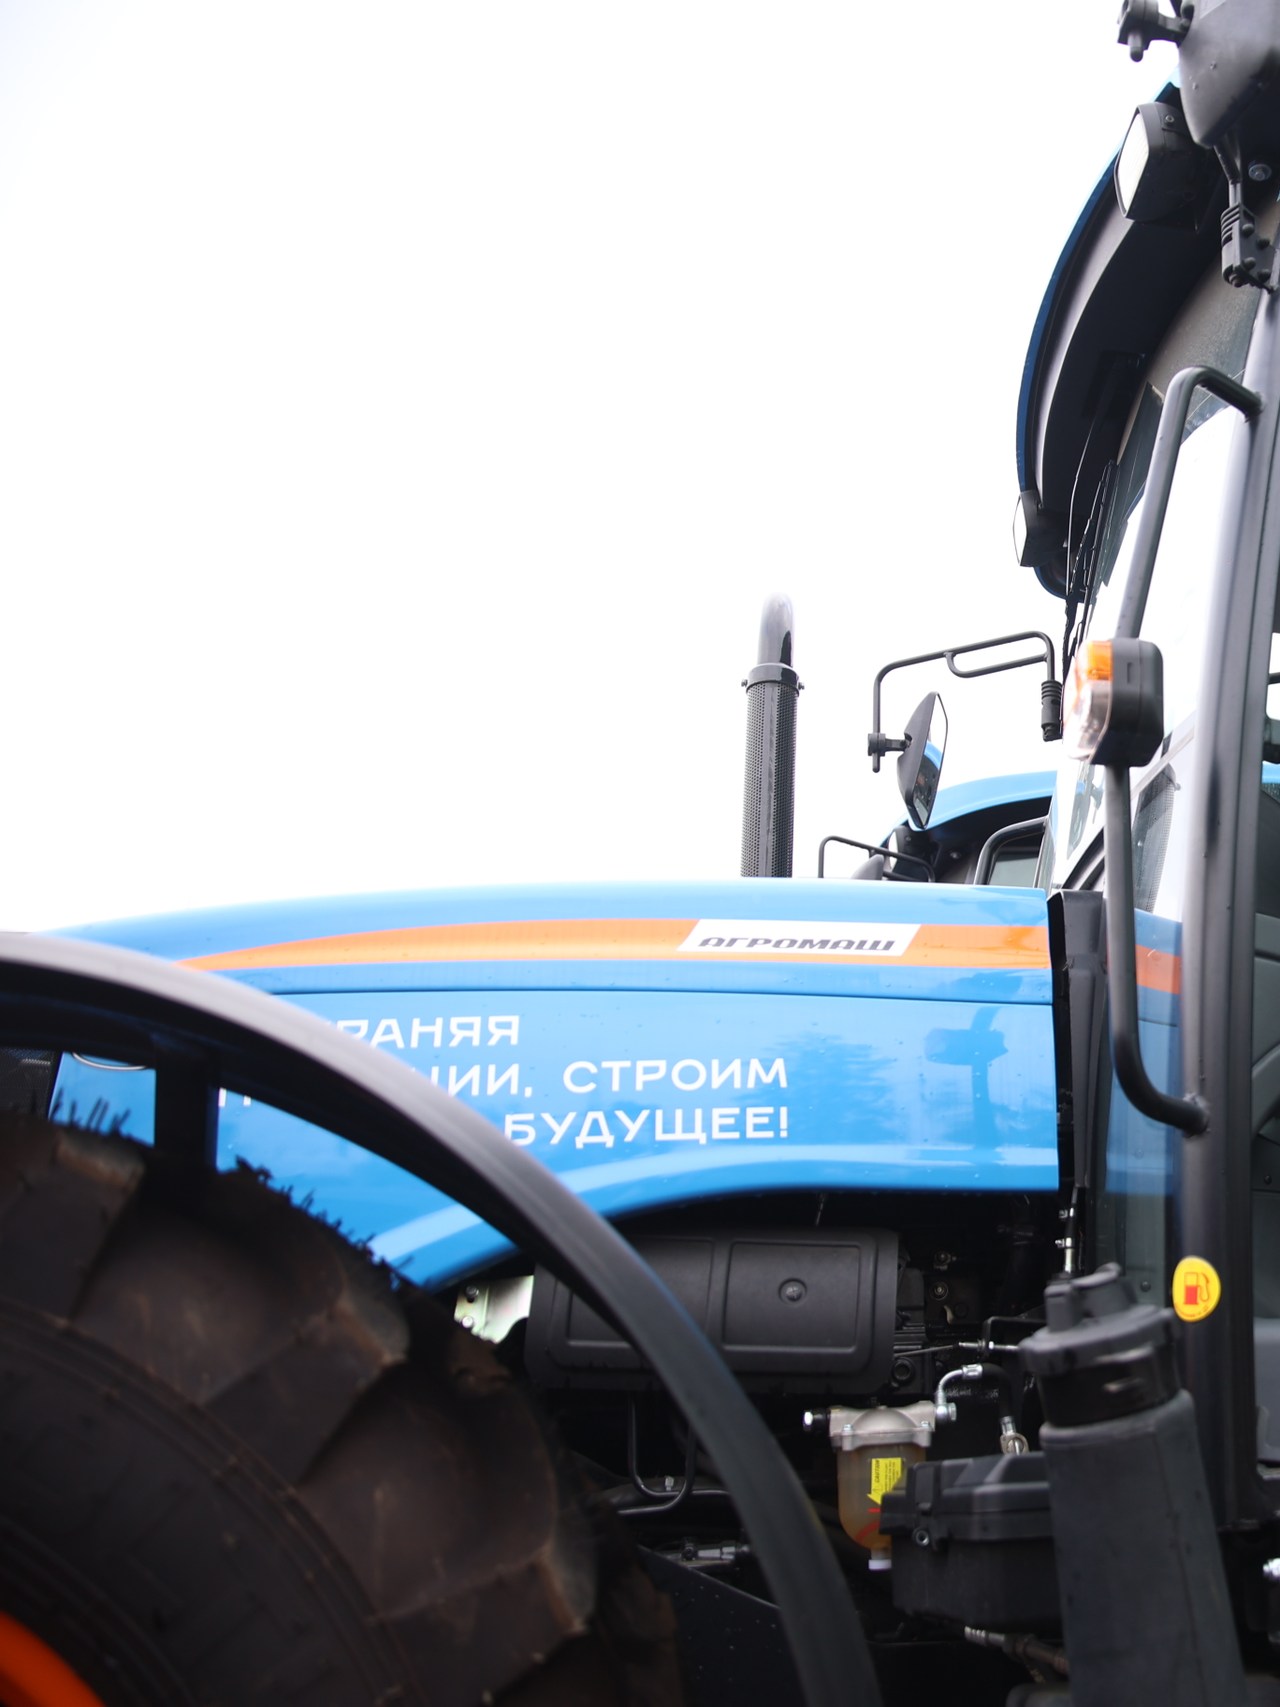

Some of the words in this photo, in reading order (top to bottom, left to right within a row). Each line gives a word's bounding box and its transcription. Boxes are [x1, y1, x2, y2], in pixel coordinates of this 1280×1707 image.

[698, 936, 896, 951] АГРОМАШ
[334, 1014, 520, 1049] РАНЯЯ
[562, 1057, 788, 1094] СТРОИМ
[503, 1105, 789, 1150] БУДУЩЕЕ!
